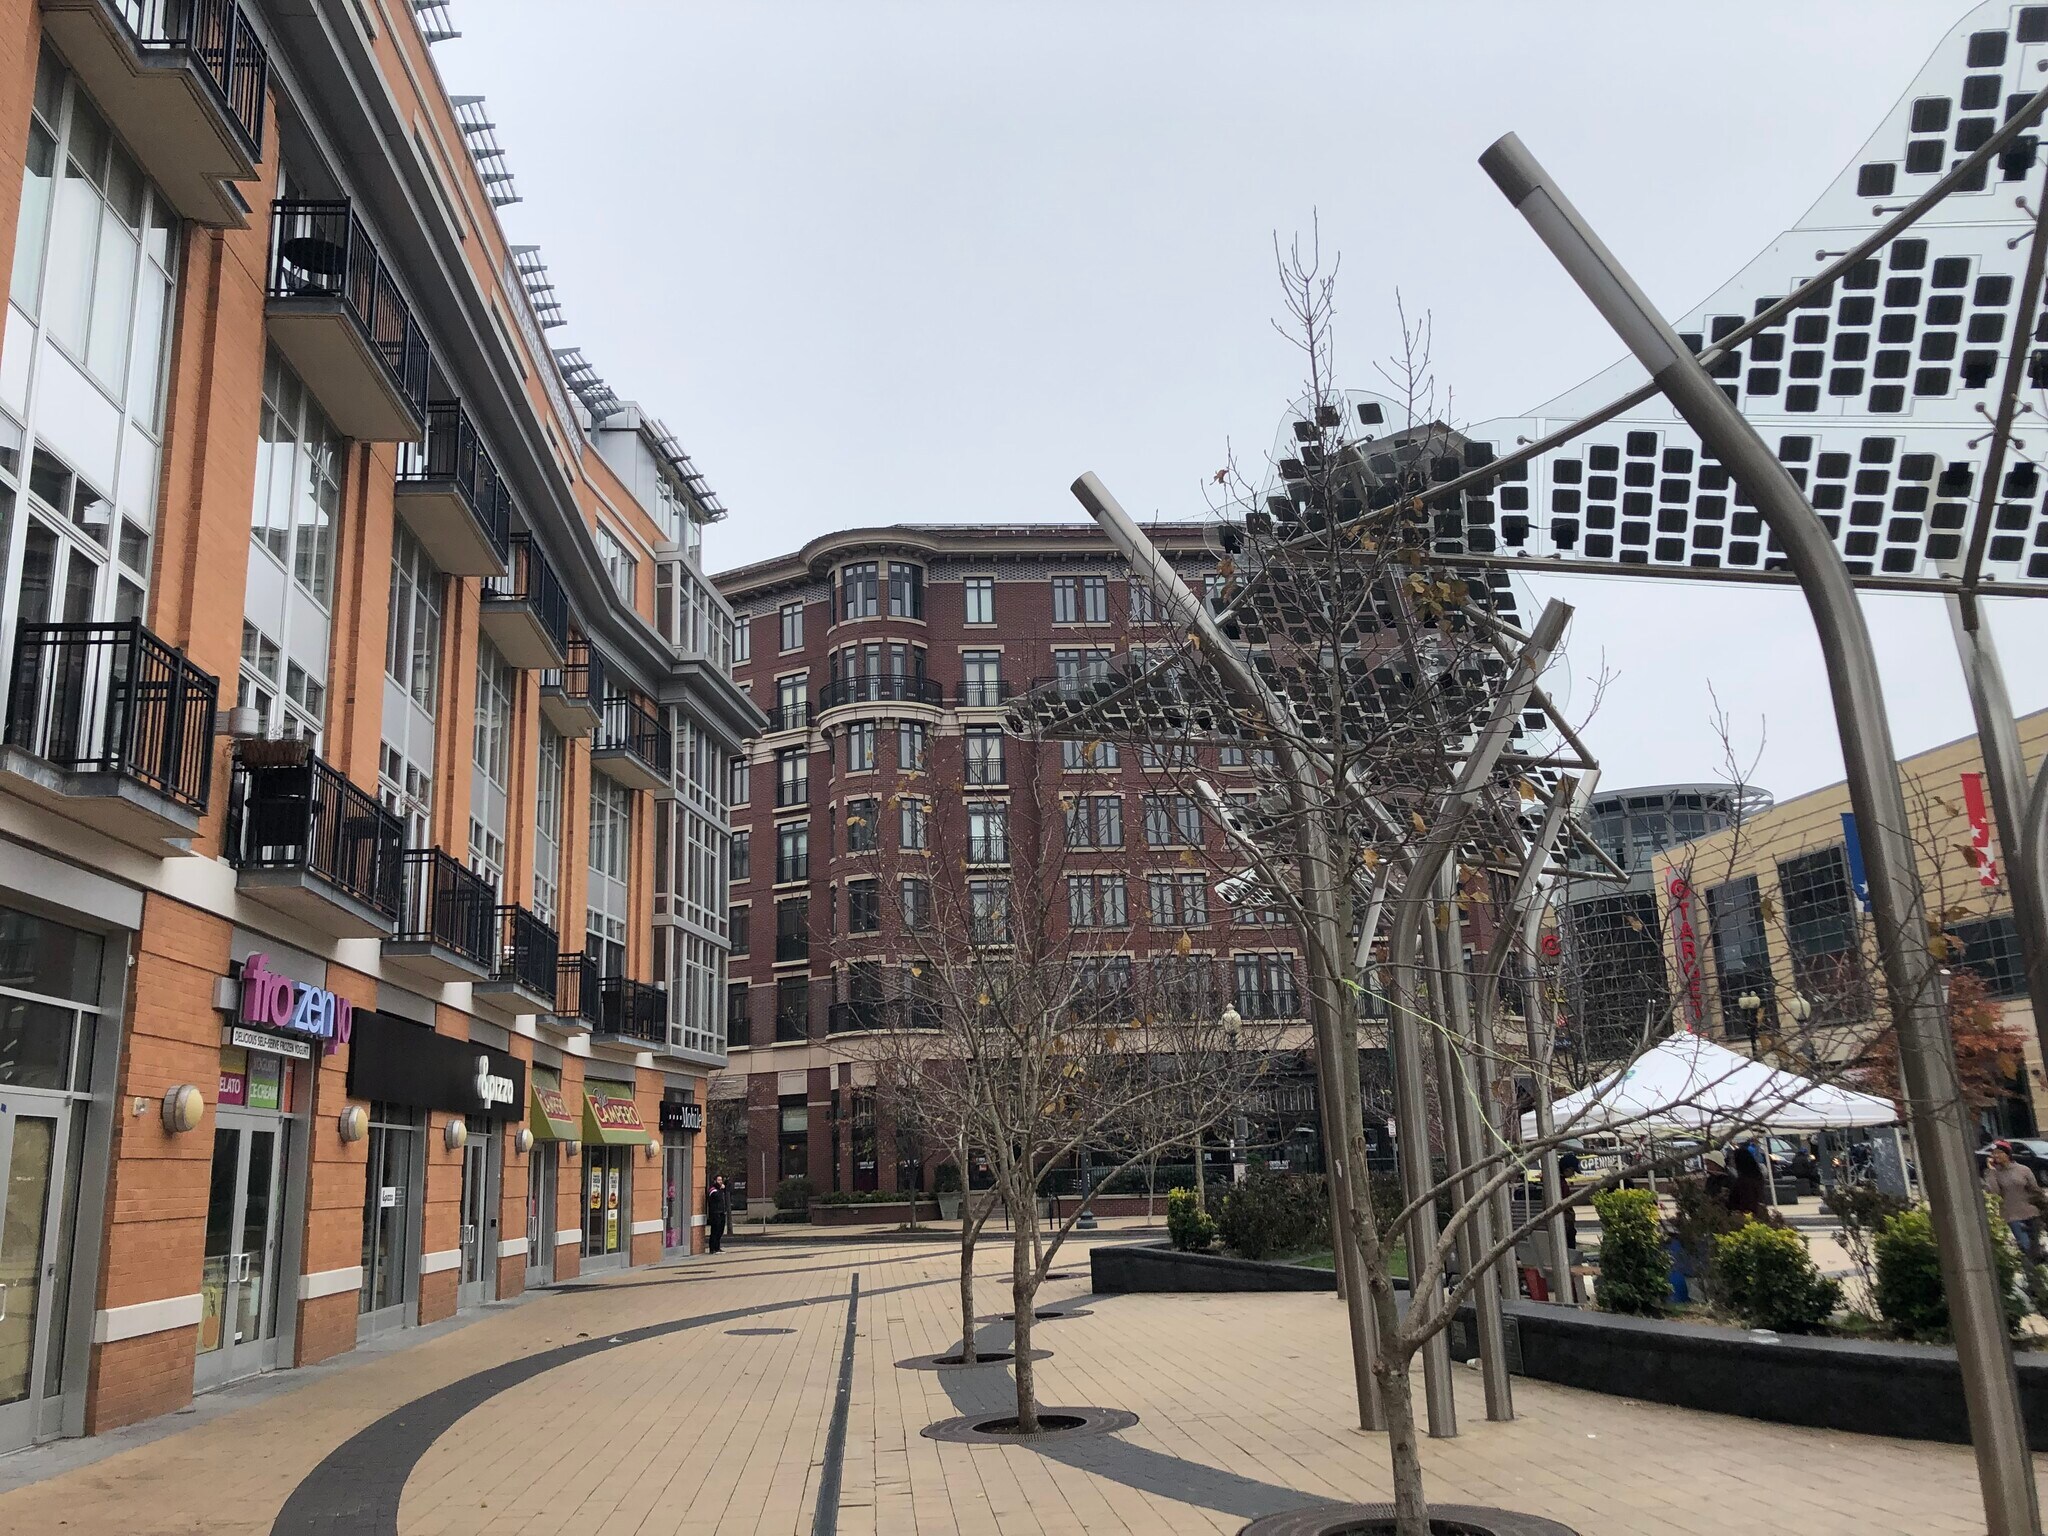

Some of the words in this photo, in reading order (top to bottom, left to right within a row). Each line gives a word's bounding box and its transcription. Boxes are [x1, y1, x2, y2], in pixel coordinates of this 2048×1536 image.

[1678, 901, 1702, 1019] TARGET
[234, 1031, 257, 1046] DELICIOUS
[280, 1040, 294, 1053] FROZEN
[294, 1043, 309, 1056] YOGURT
[219, 1077, 241, 1094] ELATO
[594, 1103, 640, 1125] CAMPERO
